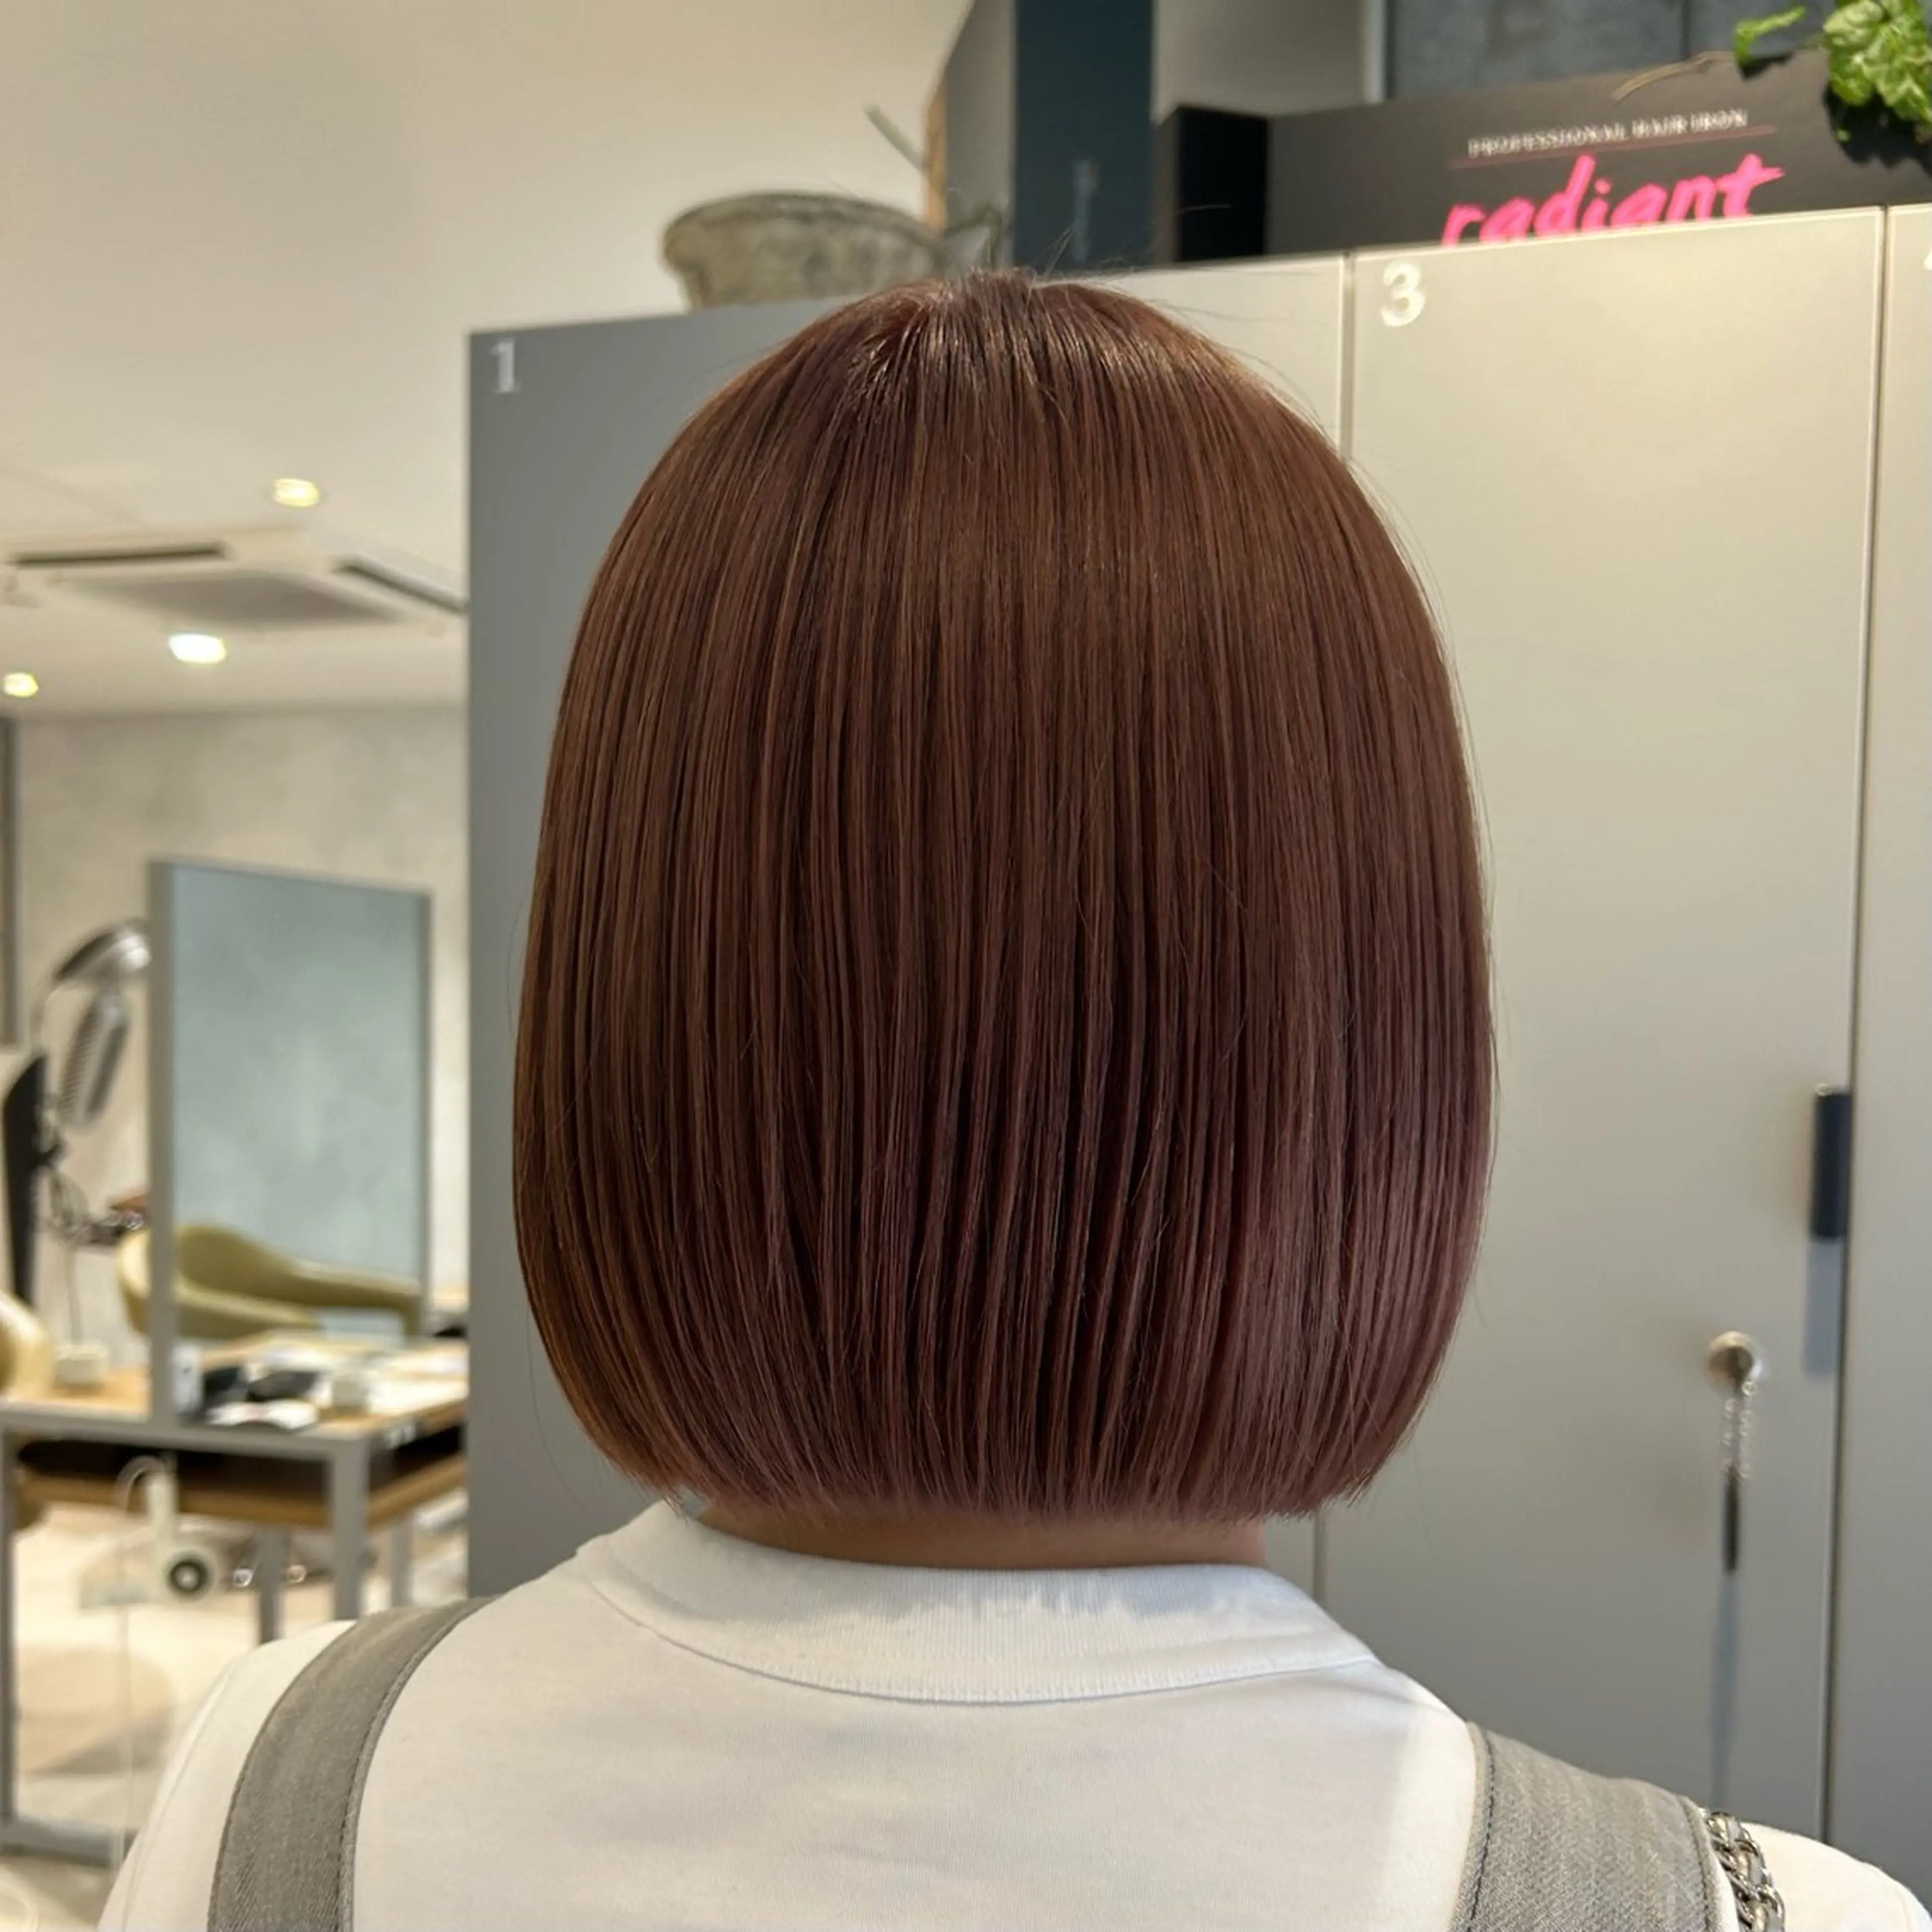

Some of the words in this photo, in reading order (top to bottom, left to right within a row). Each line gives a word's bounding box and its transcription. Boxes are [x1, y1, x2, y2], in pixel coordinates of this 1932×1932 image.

[1468, 122, 1629, 157] PROFESSIONAL
[1632, 115, 1687, 139] HAIR
[1690, 107, 1748, 133] IRON
[1441, 152, 1785, 248] radiant
[1381, 263, 1425, 327] 3
[491, 338, 520, 393] 1
